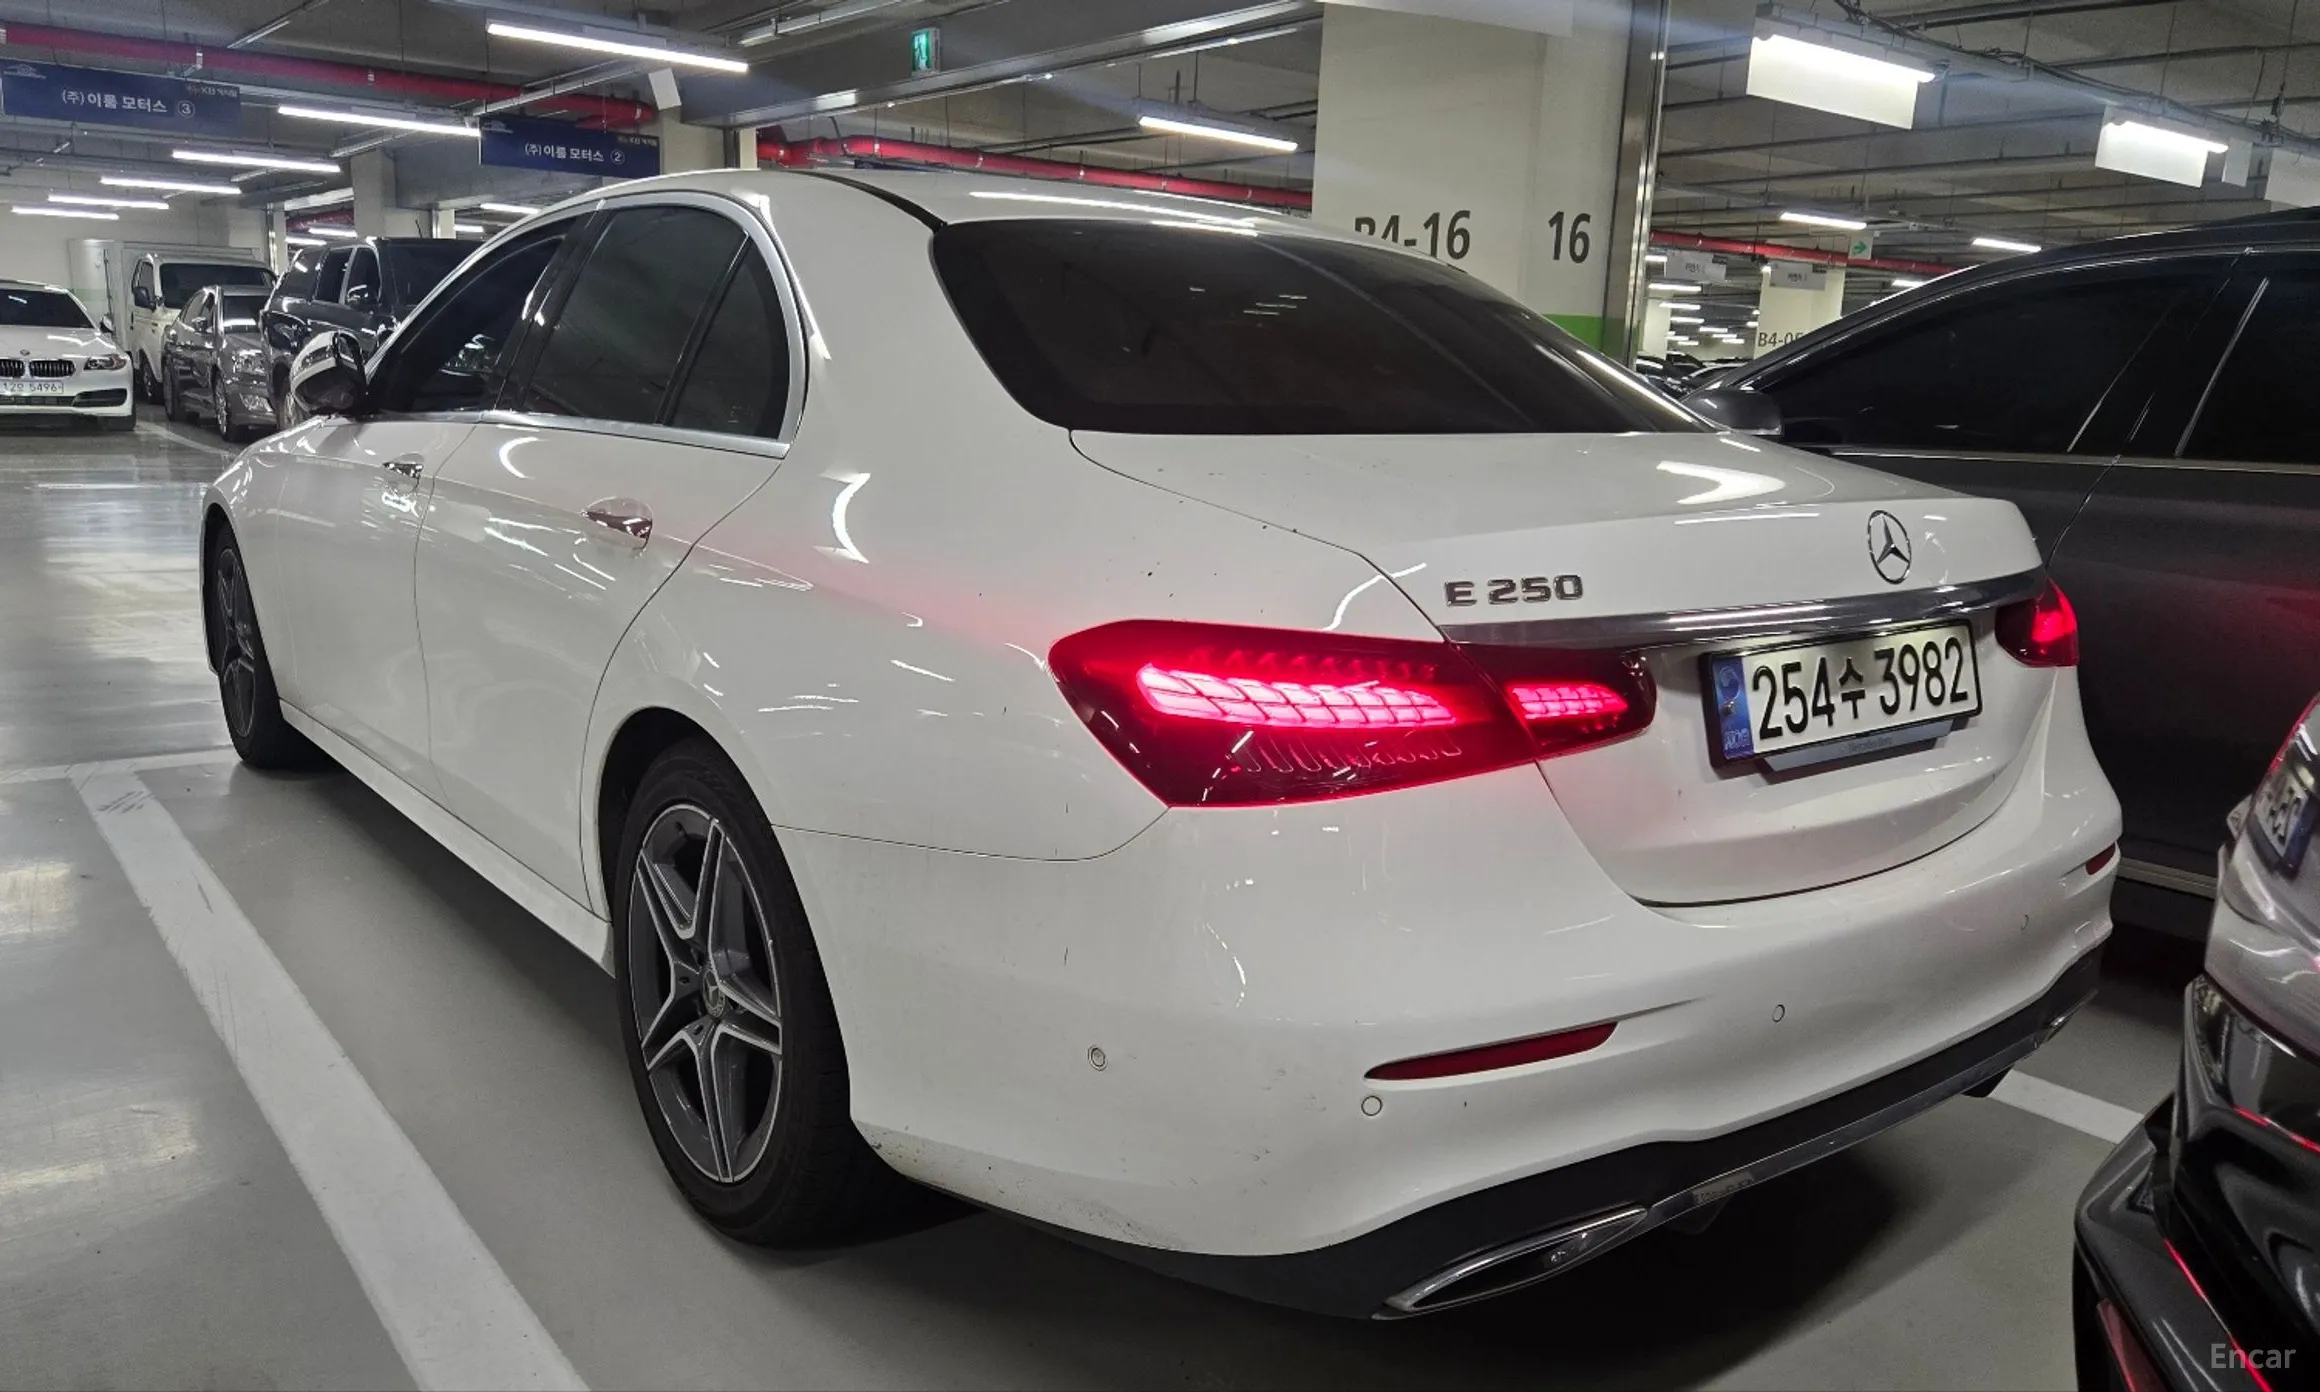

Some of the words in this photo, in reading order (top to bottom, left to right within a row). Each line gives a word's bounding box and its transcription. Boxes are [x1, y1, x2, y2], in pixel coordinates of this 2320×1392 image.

[122, 96, 168, 114] 모터스
[570, 148, 605, 162] 모터스
[1548, 211, 1592, 264] 16
[1444, 580, 1478, 607] E
[1487, 574, 1584, 606] 250
